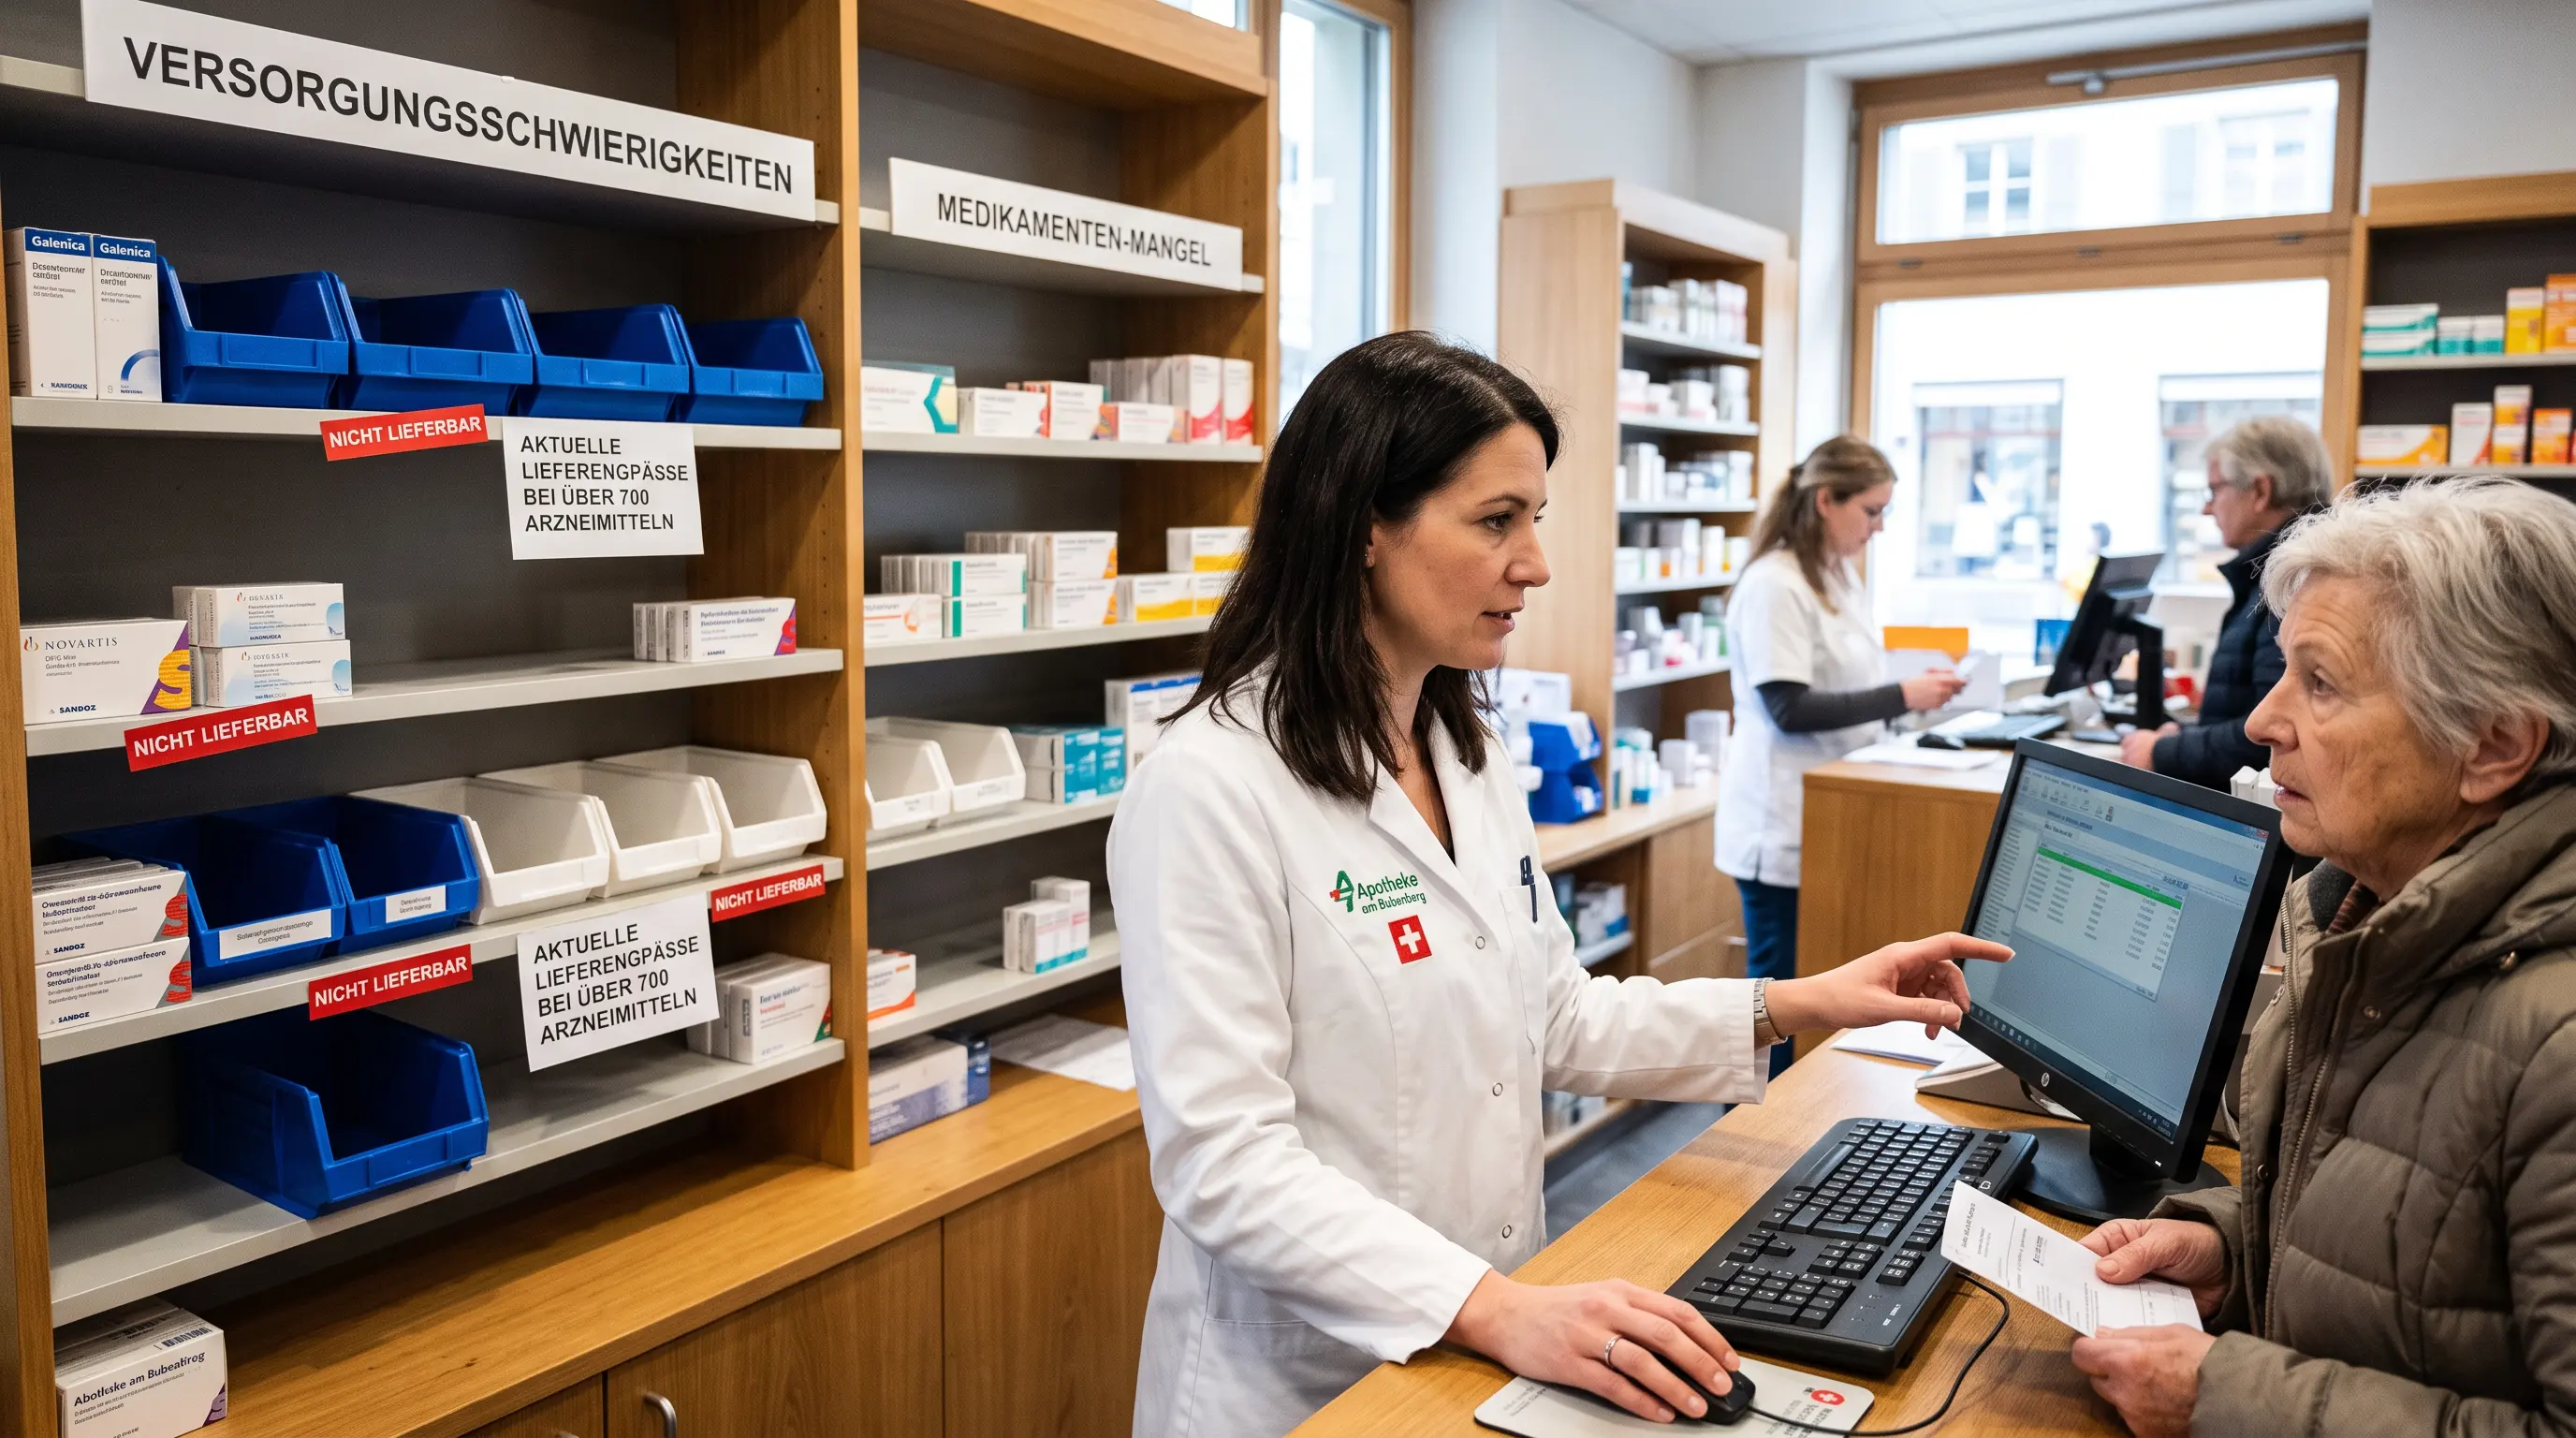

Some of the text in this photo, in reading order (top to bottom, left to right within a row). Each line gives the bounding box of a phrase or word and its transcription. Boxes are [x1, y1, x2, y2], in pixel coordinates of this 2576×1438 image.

[123, 36, 792, 194] VERSORGUNGSSCHWIERIGKEITEN
[32, 235, 85, 251] Galenica
[938, 193, 1212, 267] MEDIKAMENTEN-MANGEL
[100, 242, 151, 258] Galenica
[329, 416, 482, 448] NICHT LIEFERBAR
[520, 435, 622, 455] AKTUELLE
[521, 460, 689, 481] LIEFERENGPÄSSE
[523, 485, 650, 506] BEI ÜBER 700
[525, 513, 674, 532] ARZNEIMITTELN
[45, 637, 118, 651] NOVARTIS
[59, 704, 96, 714] SANDOZ
[134, 707, 309, 757] NICHT LIEFERBAR
[715, 873, 823, 912] NICHT LIEFERBAR
[1357, 872, 1418, 901] Apotheke
[1362, 892, 1427, 914] am Bubenberg
[53, 943, 85, 954] SANDOZ
[534, 923, 638, 963] AKTUELLE
[535, 936, 699, 990] LIEFERENGPÄSSE
[315, 956, 467, 1007] NICHT LIEFERBAR
[538, 969, 669, 1017] BEI ÜBER 700
[541, 988, 697, 1045] ARZNEIMITTELN
